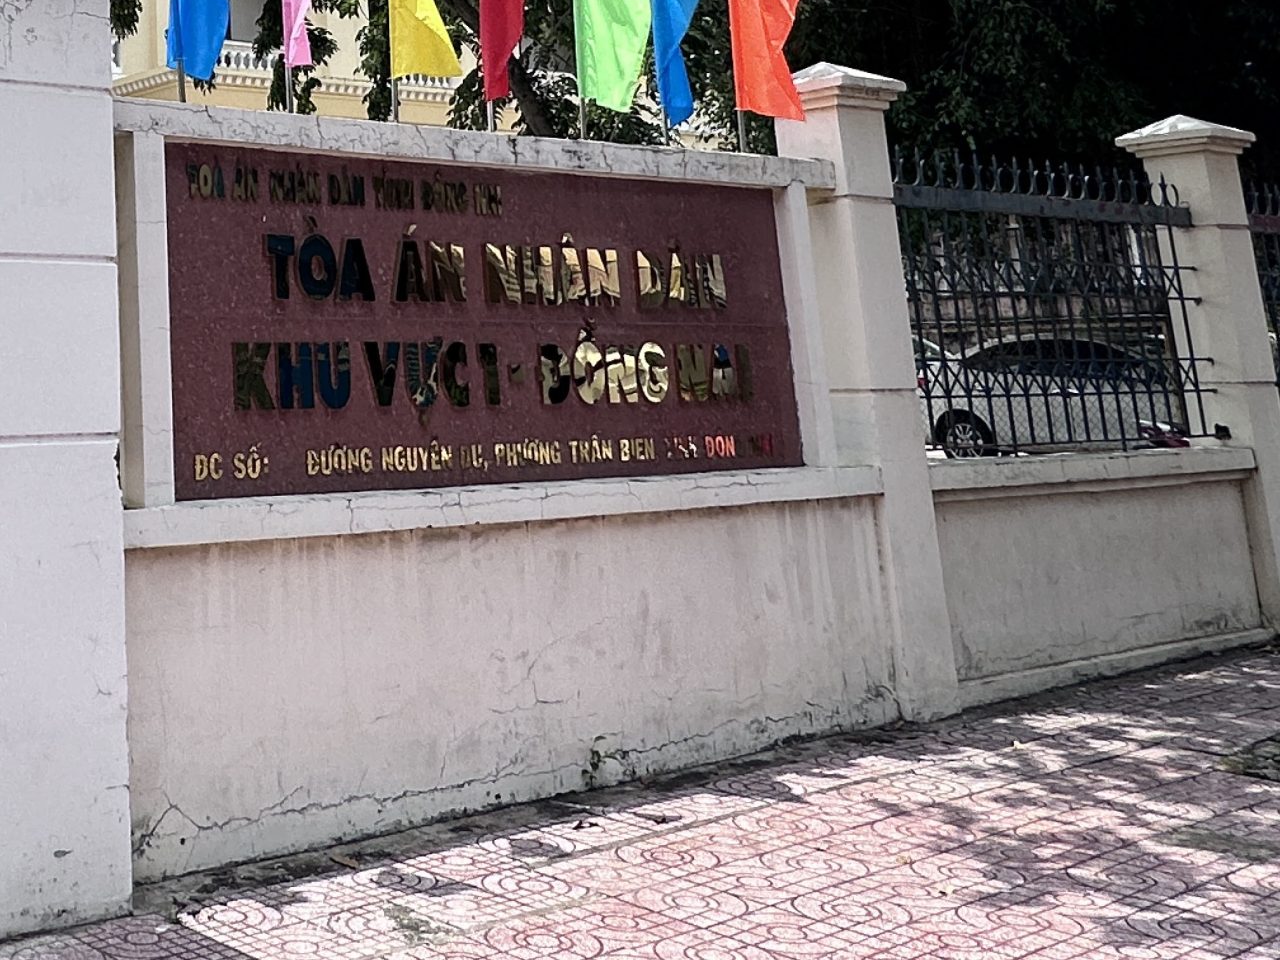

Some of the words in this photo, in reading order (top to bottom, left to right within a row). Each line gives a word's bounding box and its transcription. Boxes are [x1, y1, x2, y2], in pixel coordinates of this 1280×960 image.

[263, 215, 375, 302] TÒA
[391, 223, 467, 302] ÁN
[482, 232, 622, 307] NHÂN
[636, 237, 728, 309] DÂN
[231, 341, 352, 411] KHU
[362, 336, 470, 426] VỰC
[536, 316, 669, 405] ĐỒNG
[674, 343, 753, 404] NAI
